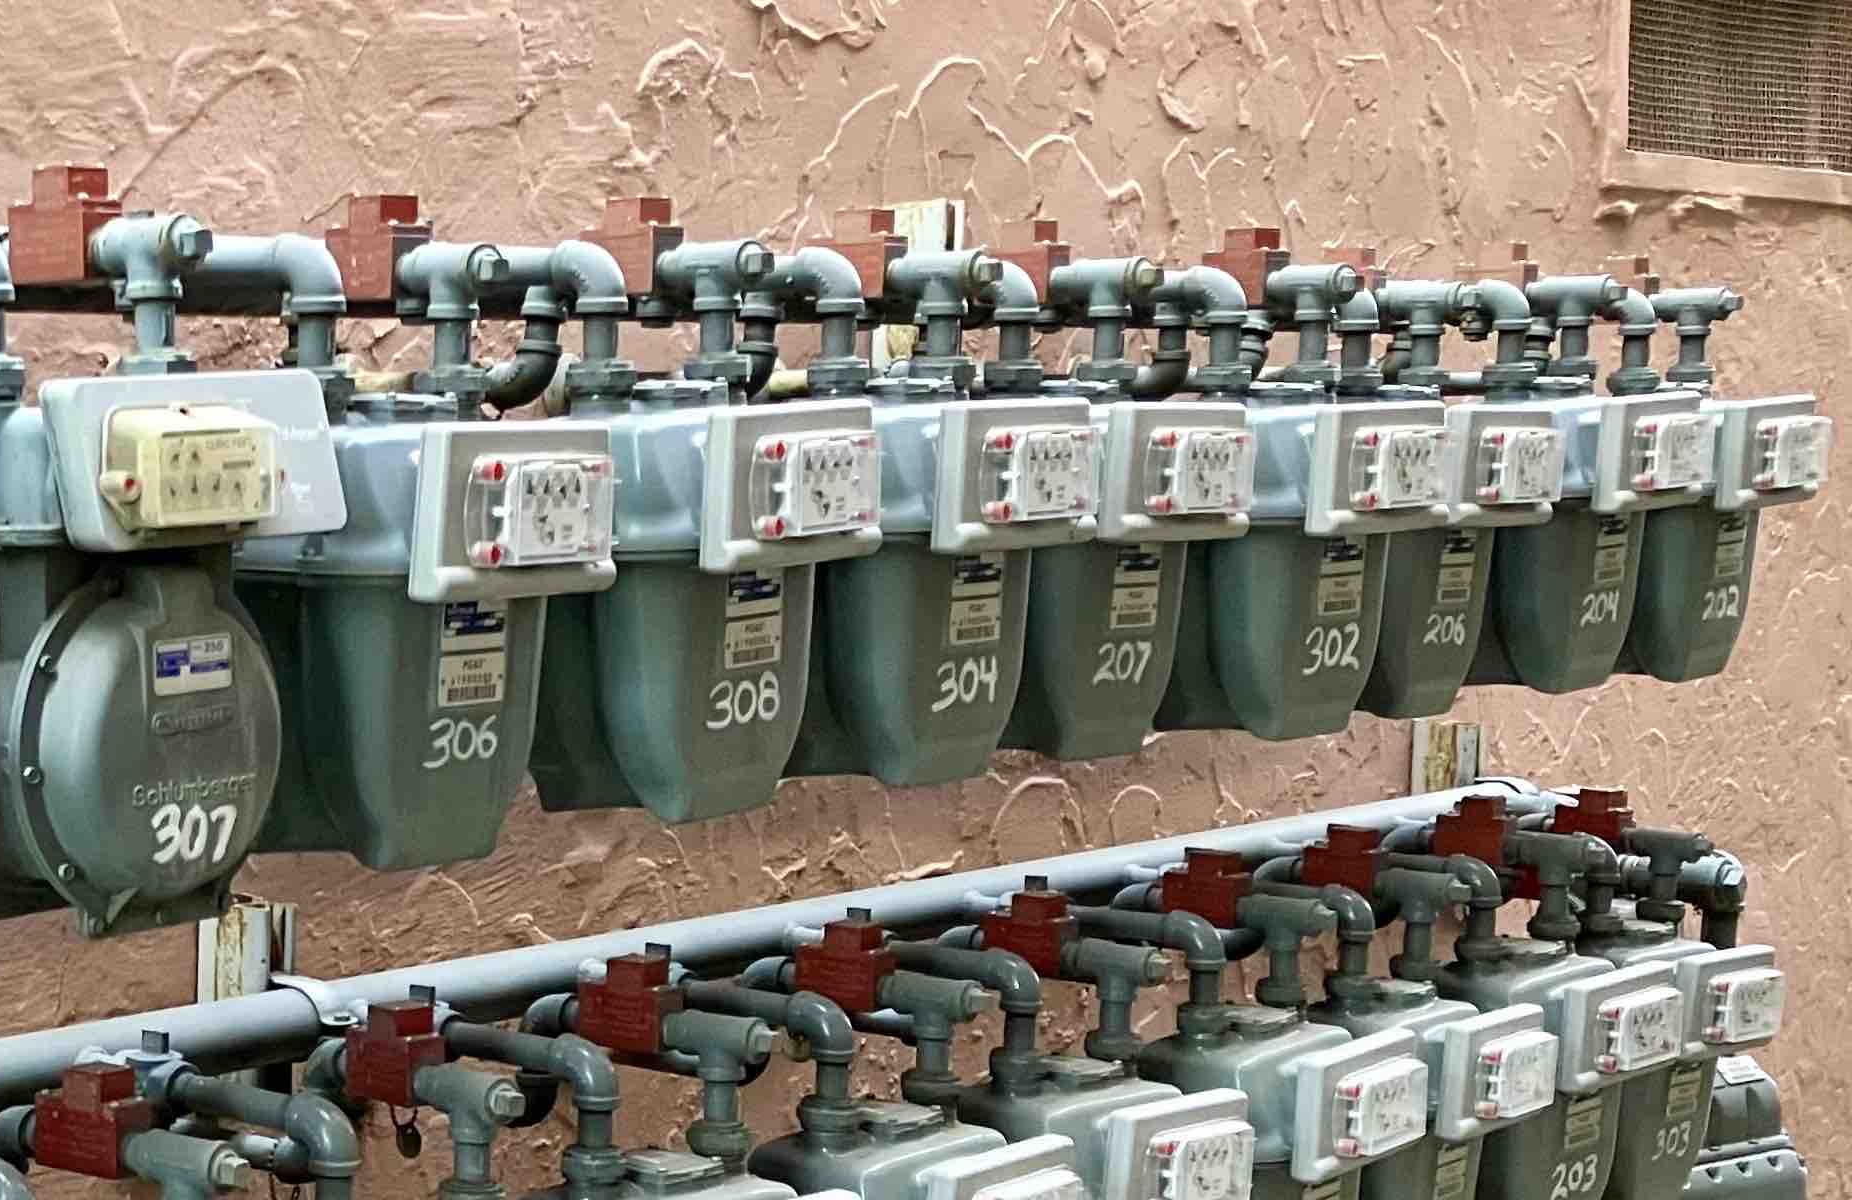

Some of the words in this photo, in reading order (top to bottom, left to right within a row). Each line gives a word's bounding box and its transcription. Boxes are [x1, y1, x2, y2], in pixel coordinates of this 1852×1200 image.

[1580, 591, 1620, 628] 204
[1701, 585, 1740, 621] 202
[1302, 622, 1360, 676] 302
[1423, 613, 1466, 646] 206
[932, 655, 998, 712] 304
[1092, 641, 1153, 685] 207
[706, 670, 780, 729] 308
[422, 715, 497, 768] 306
[132, 772, 256, 807] Schlumberger
[151, 803, 237, 864] 307
[1651, 1121, 1692, 1161] 303
